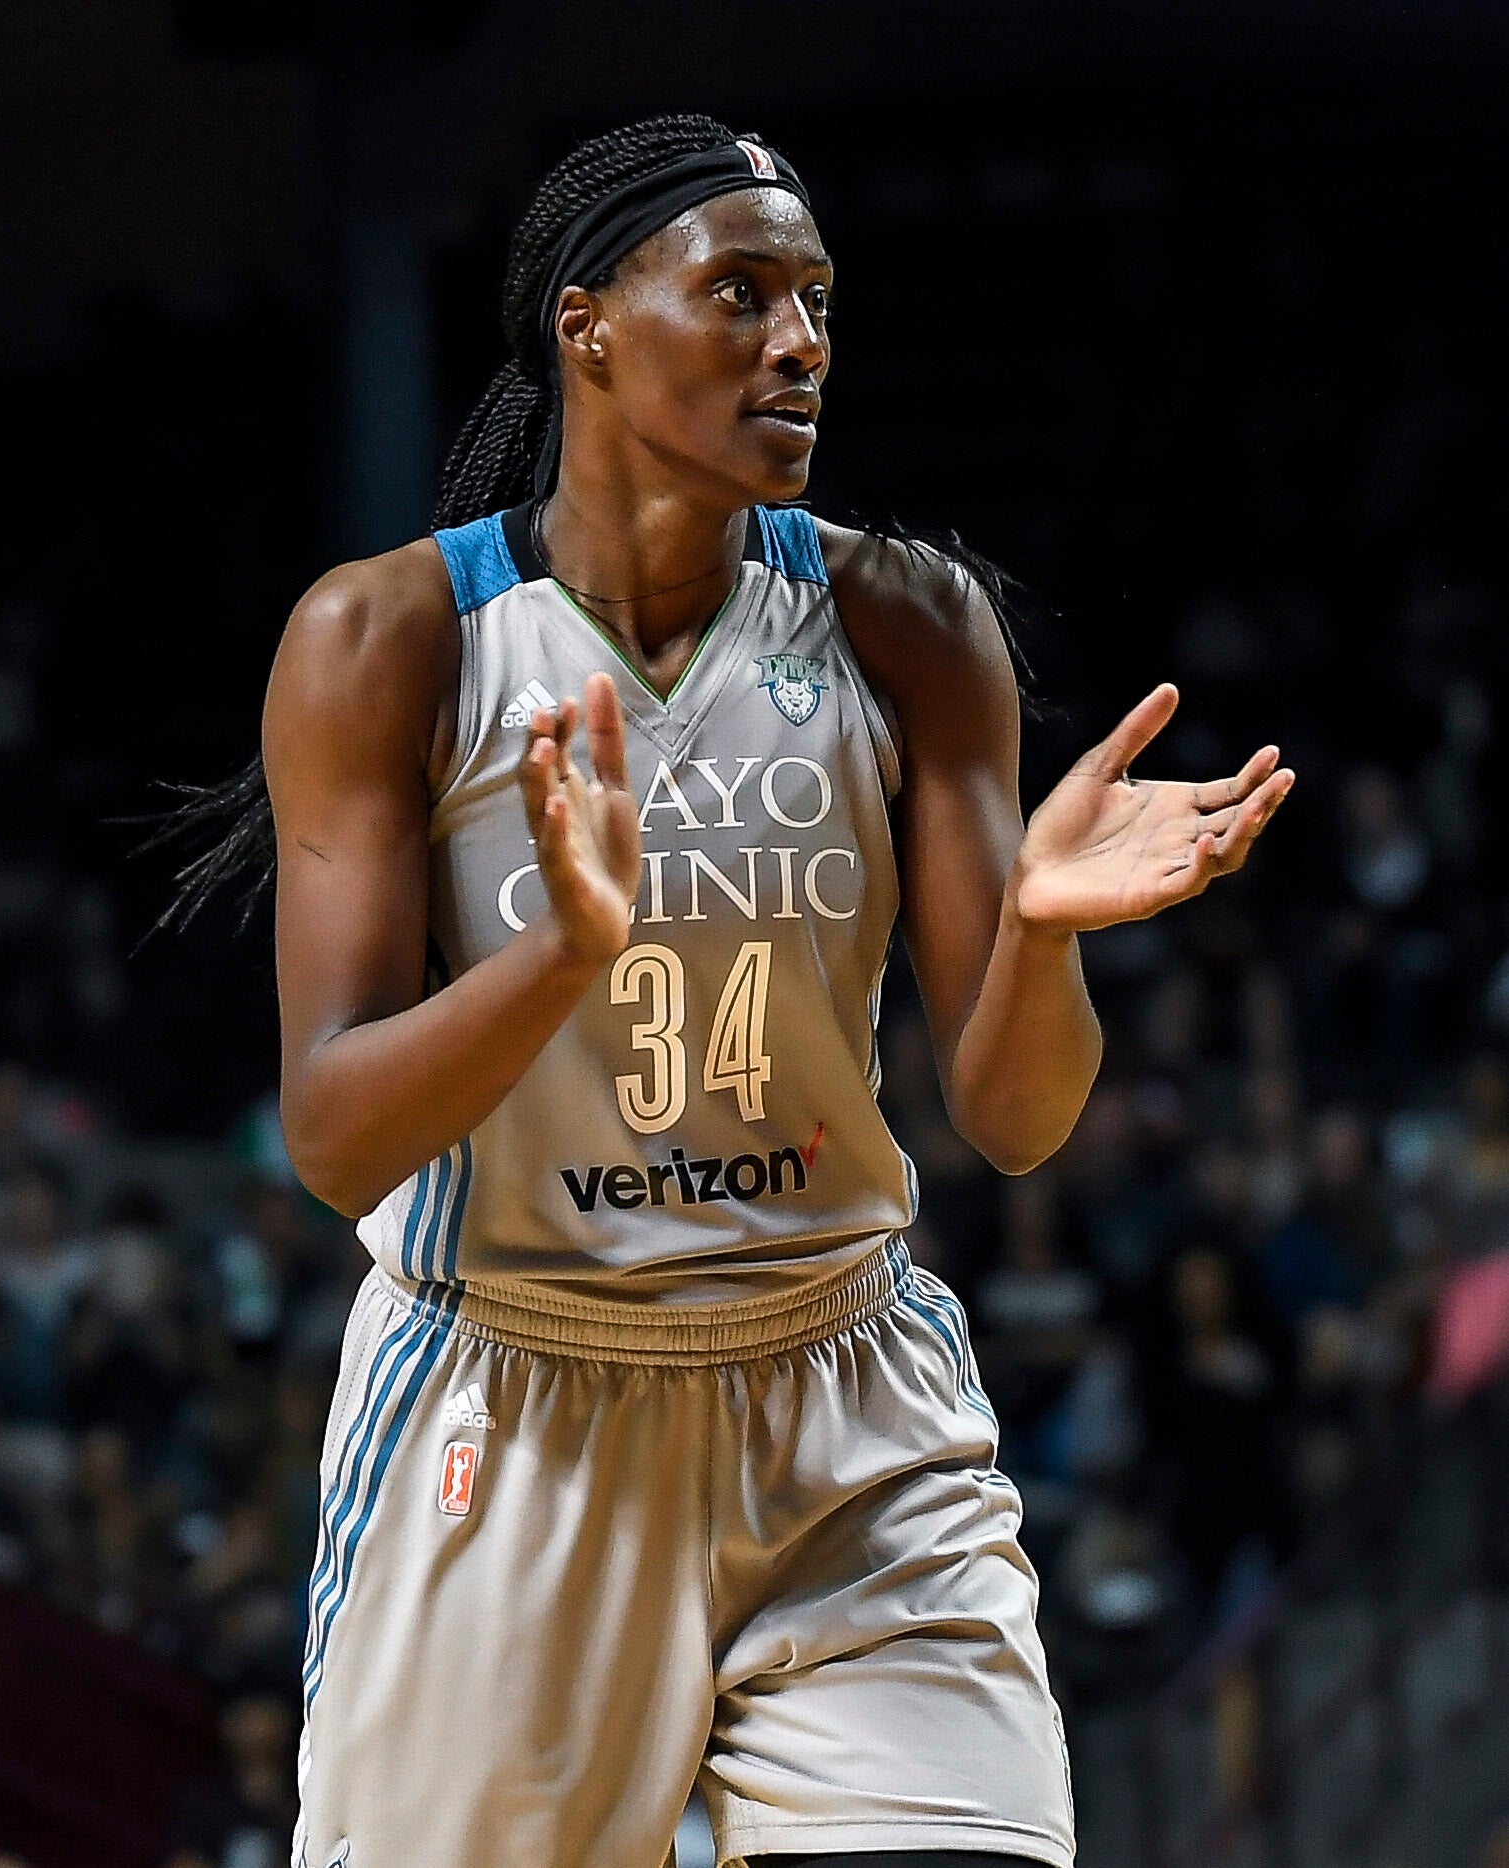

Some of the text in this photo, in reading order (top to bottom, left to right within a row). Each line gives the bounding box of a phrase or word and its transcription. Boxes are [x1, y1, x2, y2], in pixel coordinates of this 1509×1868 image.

[528, 756, 833, 845] AYO
[496, 847, 857, 933] CINIC
[610, 941, 773, 1135] 34
[559, 1146, 807, 1213] verizon
